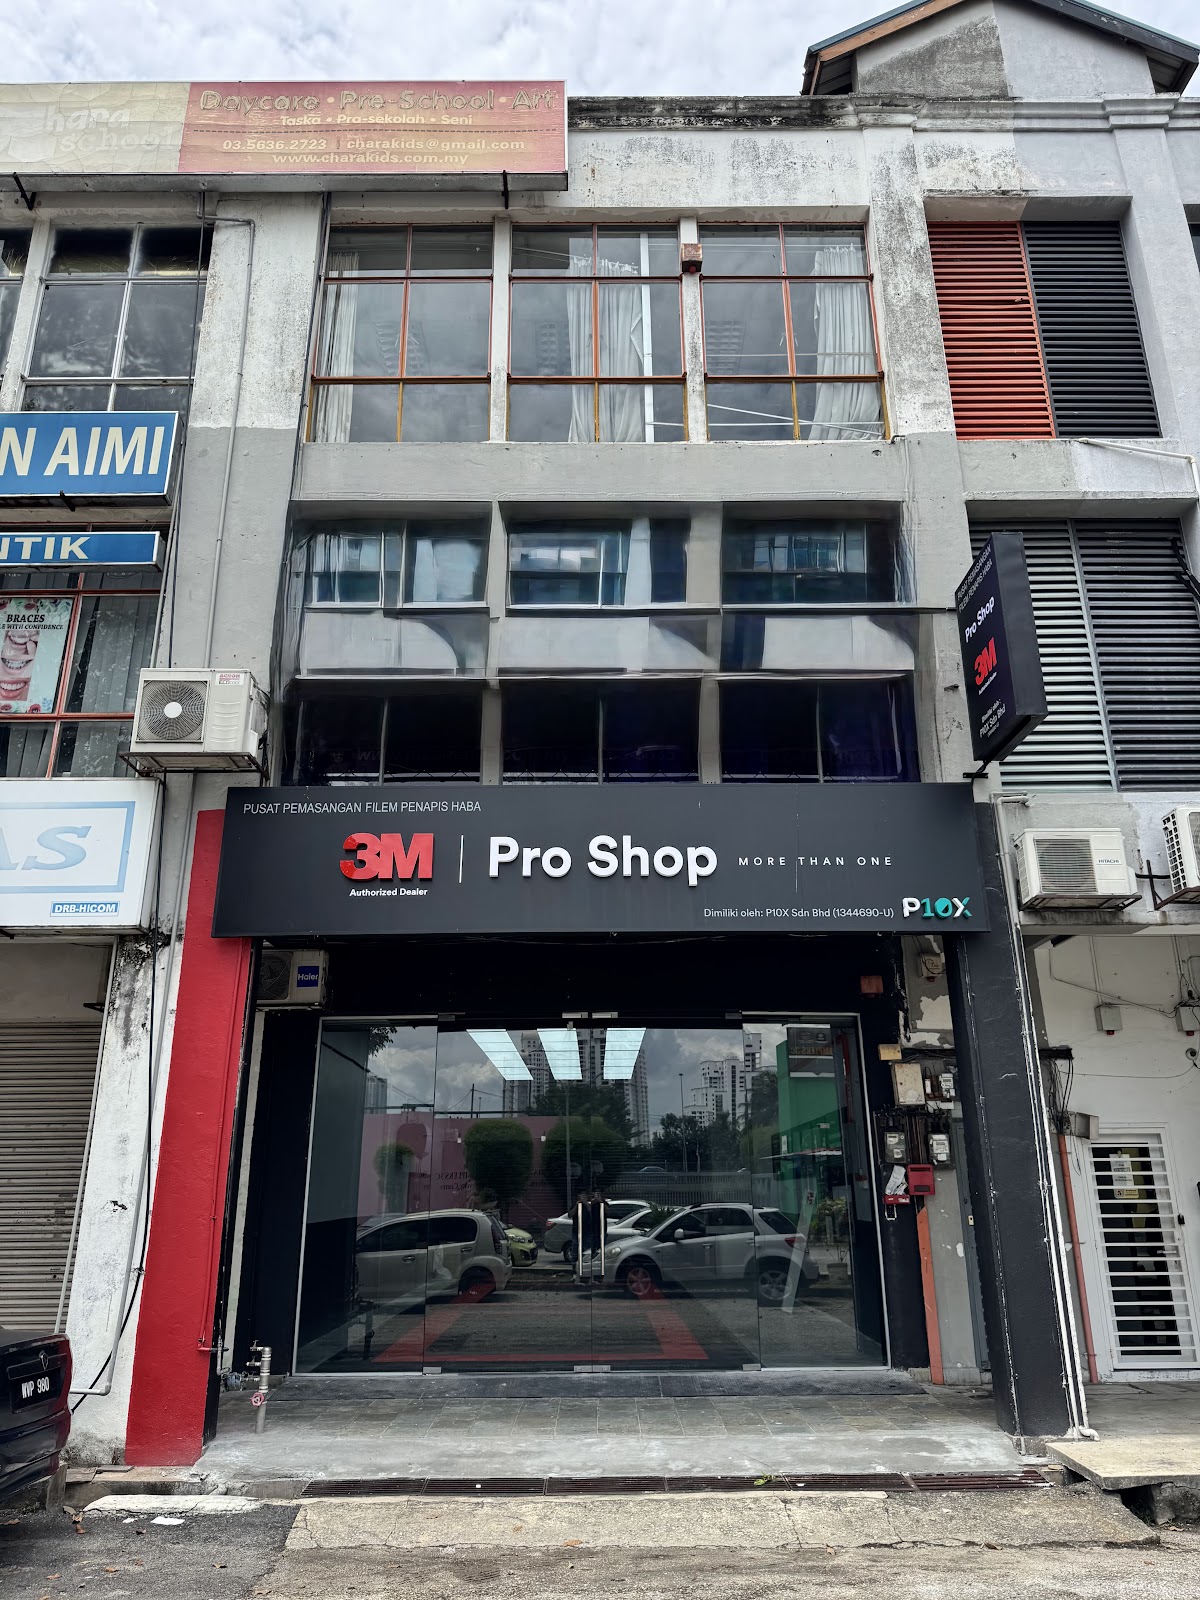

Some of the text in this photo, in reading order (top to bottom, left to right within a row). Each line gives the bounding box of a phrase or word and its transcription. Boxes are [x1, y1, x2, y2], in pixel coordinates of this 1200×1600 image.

[200, 90, 320, 115] Daycare
[512, 90, 554, 110] Art
[280, 113, 473, 126] Taska Pra-sekolah Seni
[222, 137, 527, 152] 03.5636.2723 charakids@gmail.com
[271, 151, 470, 165] www.charakids.com.my
[43, 426, 165, 476] AIMI
[6, 614, 45, 623] BRACES
[965, 597, 995, 643] Pro Shop
[974, 637, 997, 685] 3M
[243, 801, 482, 814] PUSAT PEMASANGAN FILEM PENAPIS HABA
[339, 832, 892, 887] 3M Pro Shop MORE THAN ONE
[349, 888, 428, 897] Authorized Dealer
[54, 904, 117, 913] DRB-HICOM
[704, 908, 895, 919] Dimiliki oleh: P10X Sdn Bhd (1344690-U)
[902, 897, 972, 919] P10X
